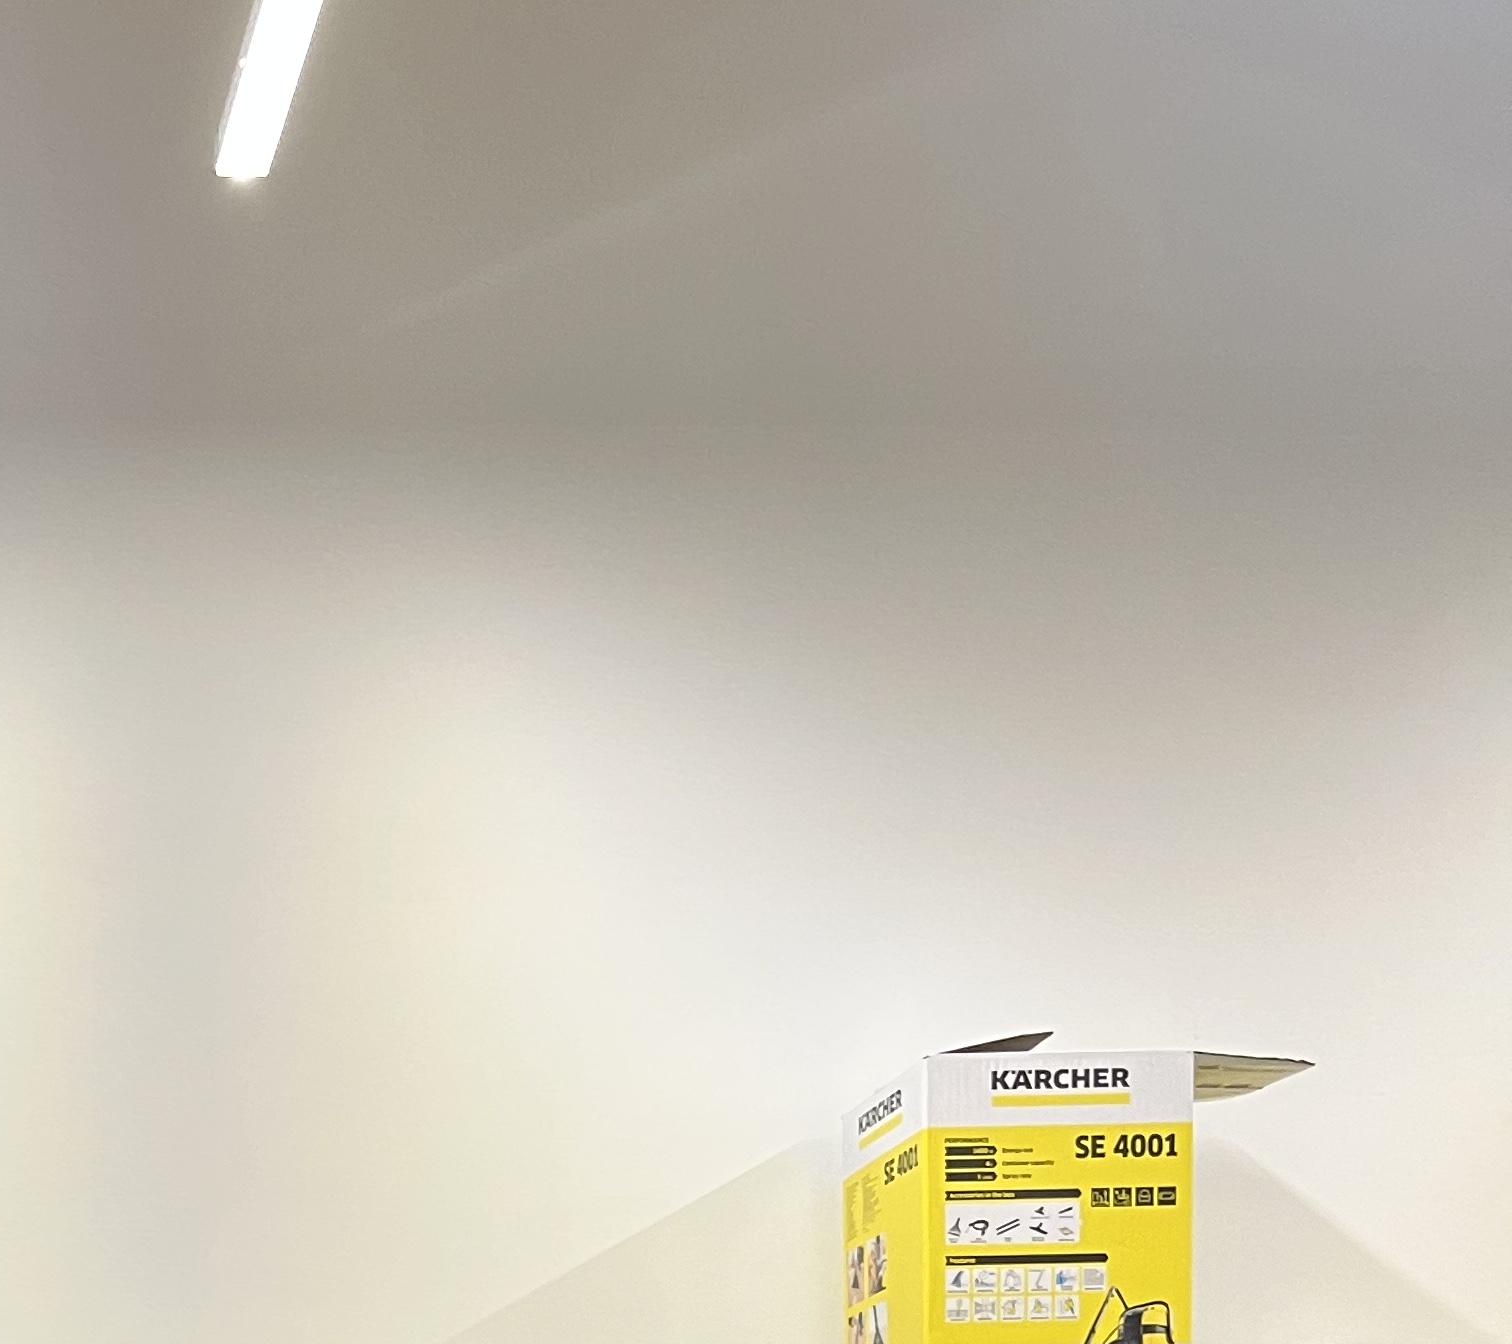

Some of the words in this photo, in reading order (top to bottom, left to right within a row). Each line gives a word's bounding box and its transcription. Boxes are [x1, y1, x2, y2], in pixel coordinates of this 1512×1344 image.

[991, 1068, 1130, 1090] KÄRCHER
[858, 1089, 902, 1136] KÄRCHER
[1075, 1135, 1106, 1158] SE
[1113, 1133, 1178, 1158] 4001
[884, 1162, 895, 1185] SE
[897, 1143, 918, 1175] 4001
